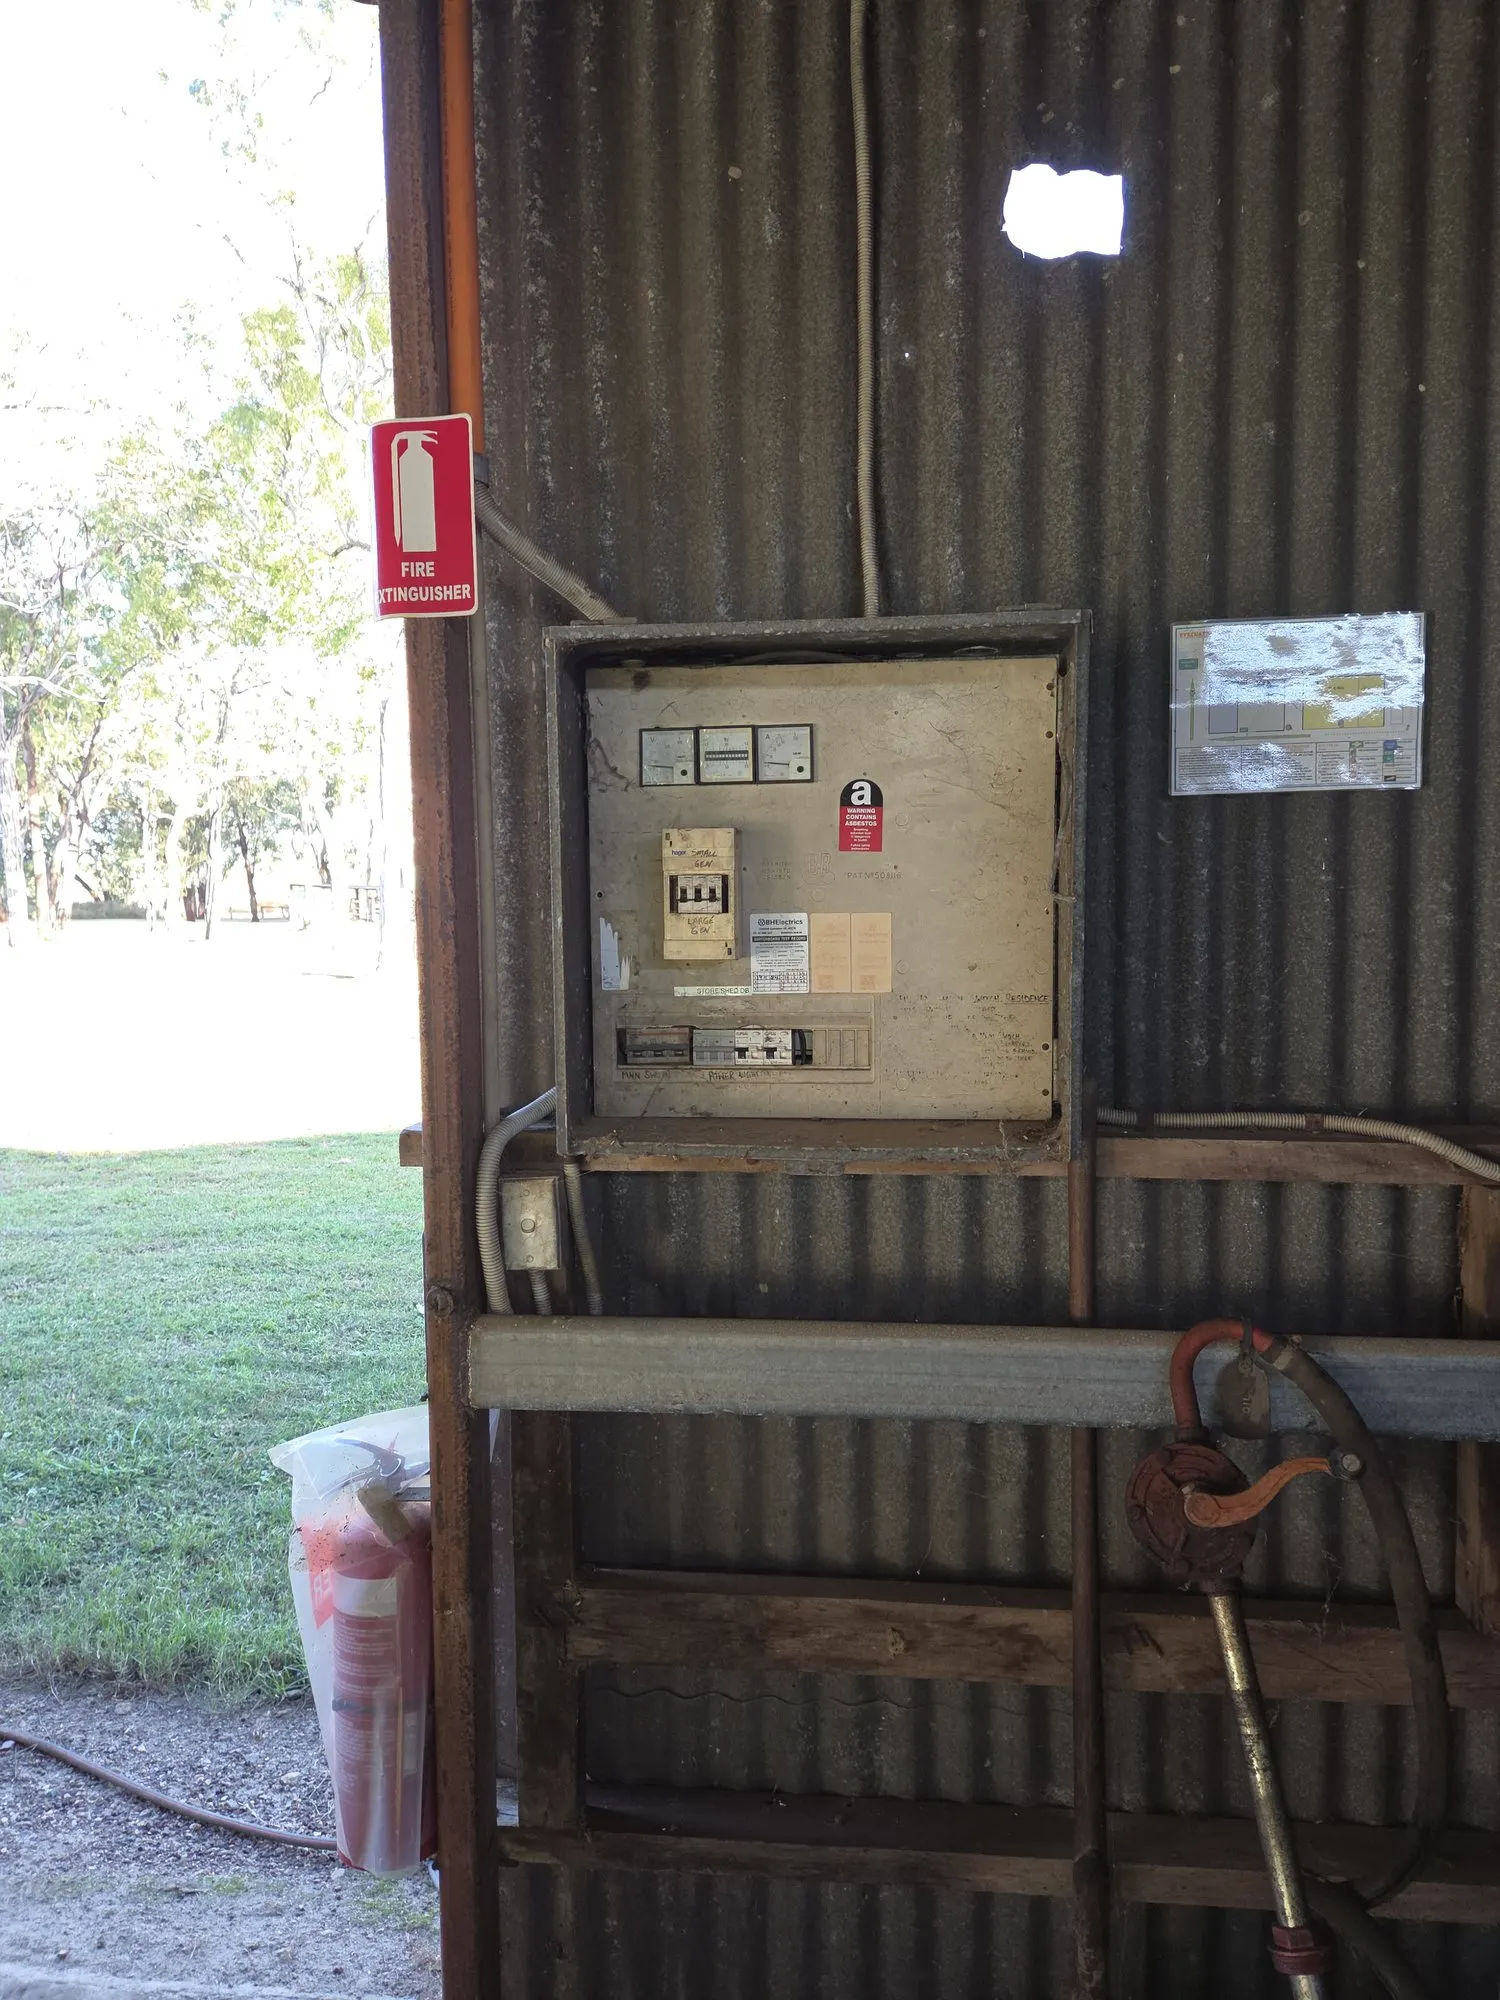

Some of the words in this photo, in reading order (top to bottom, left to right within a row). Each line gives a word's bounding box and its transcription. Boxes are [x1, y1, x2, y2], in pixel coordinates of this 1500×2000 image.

[401, 561, 435, 577] FIRE
[375, 583, 472, 604] XTINGUISHER
[850, 780, 872, 806] a
[691, 848, 718, 858] SMALL
[694, 859, 713, 869] GEN
[687, 914, 716, 926] LARGE
[720, 987, 739, 995] SHED
